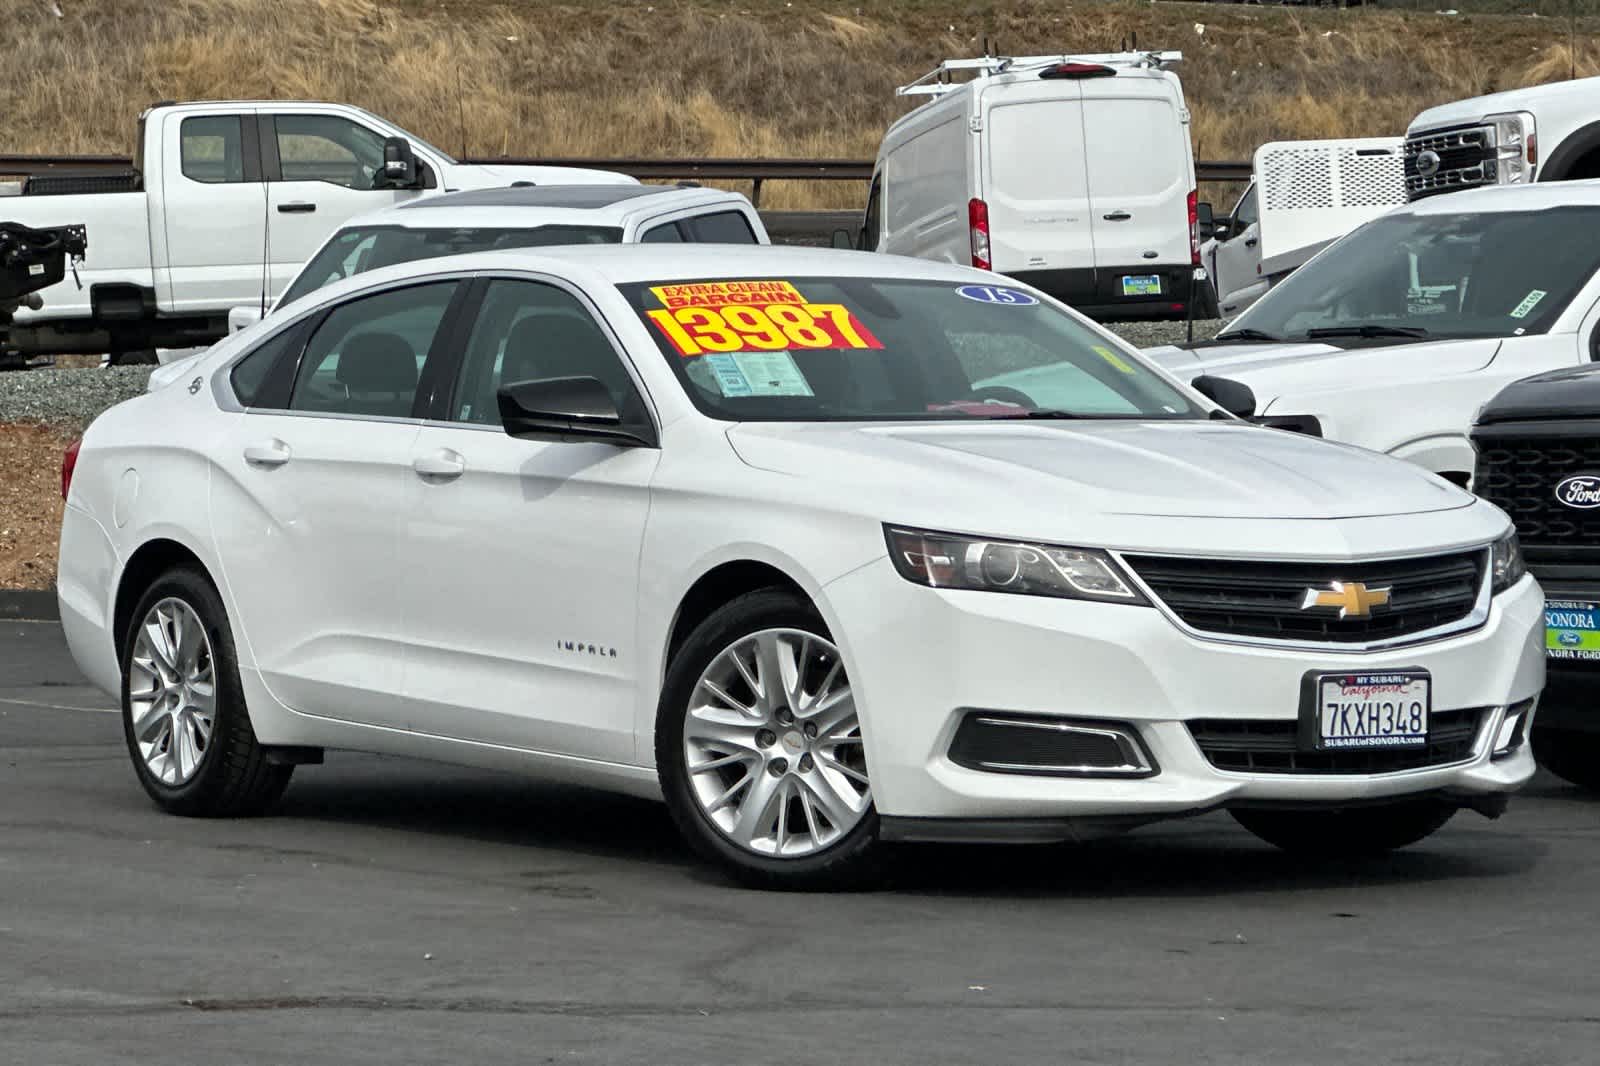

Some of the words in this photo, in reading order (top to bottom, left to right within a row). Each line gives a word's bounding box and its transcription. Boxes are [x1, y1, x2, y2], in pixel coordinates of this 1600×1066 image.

[662, 283, 725, 297] EXTRA
[726, 281, 785, 293] CLEAN
[983, 287, 1016, 303] 15
[667, 292, 798, 306] BARGAIN
[647, 303, 869, 356] 13987
[1566, 480, 1600, 502] Ford
[1545, 612, 1596, 628] SONORA
[557, 640, 617, 658] IMPALA
[1546, 649, 1575, 659] NORA
[1356, 676, 1369, 684] MY
[1371, 676, 1405, 684] SUBARU
[1341, 685, 1408, 699] California
[1327, 702, 1423, 736] 7KXH348
